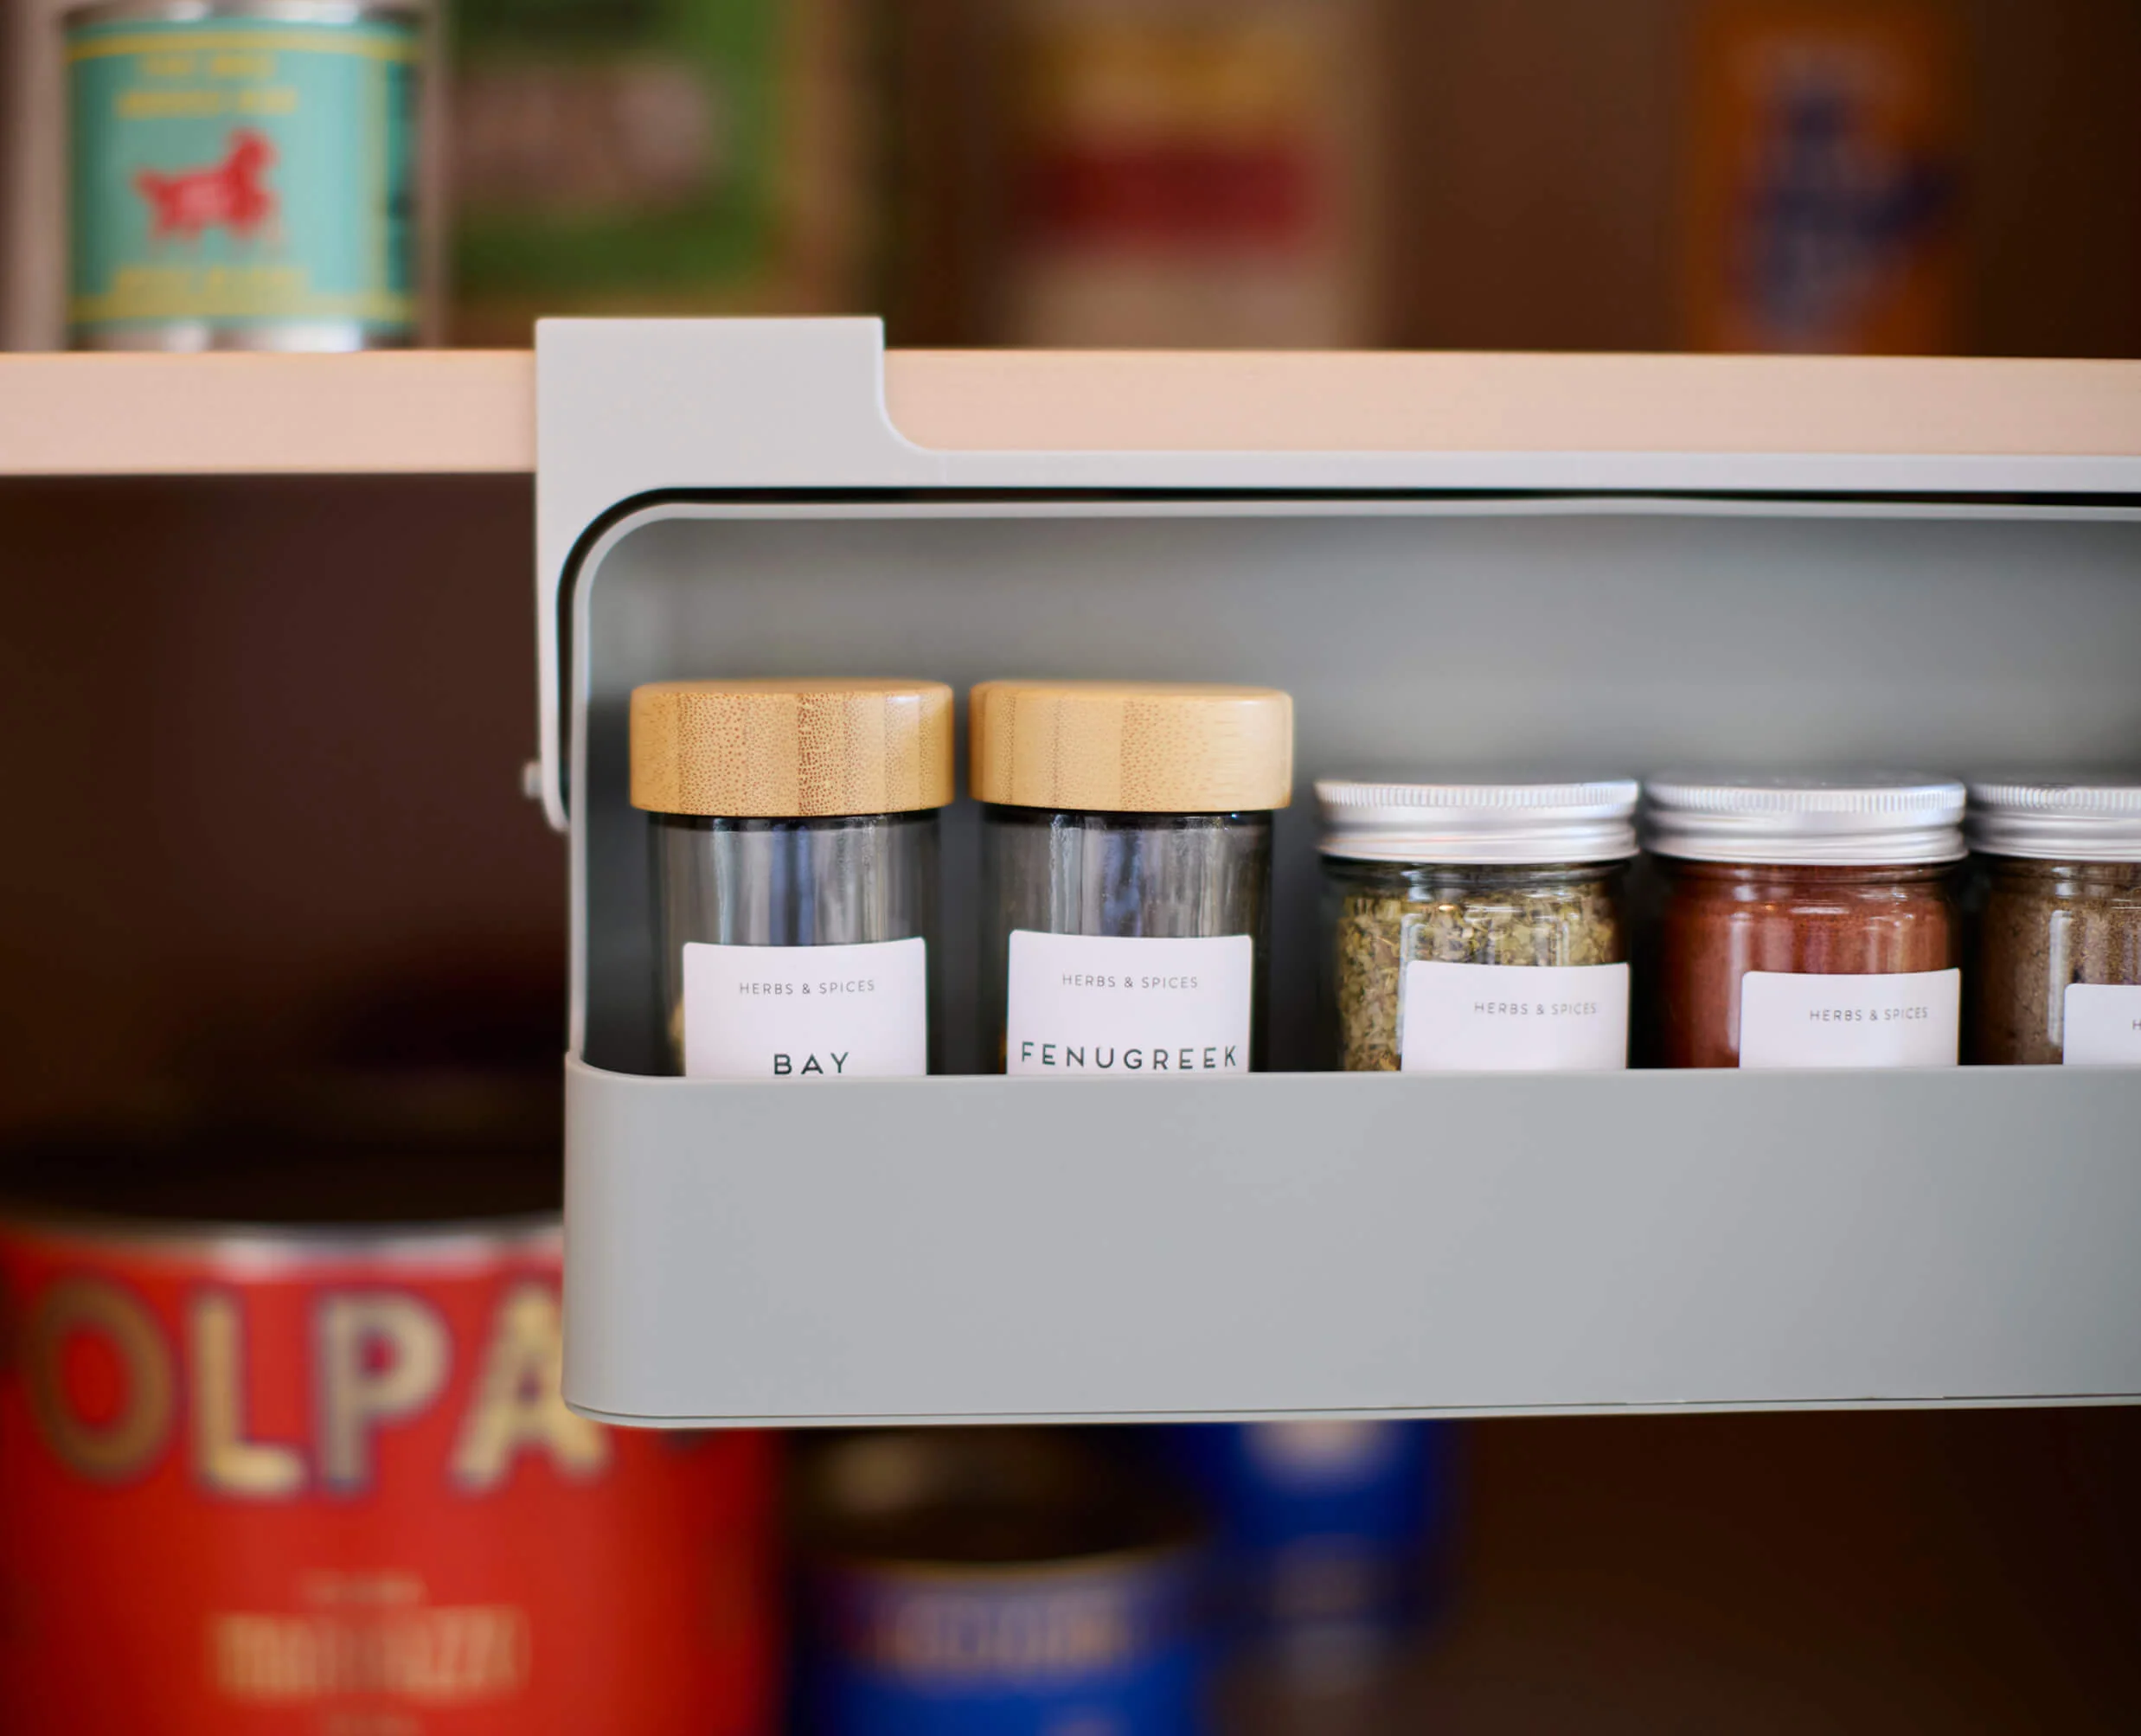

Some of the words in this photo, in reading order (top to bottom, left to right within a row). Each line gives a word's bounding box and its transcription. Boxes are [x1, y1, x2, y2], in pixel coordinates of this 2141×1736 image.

[739, 982, 793, 996] HERBS
[801, 983, 811, 995] &
[818, 979, 875, 996] SPICES
[1062, 974, 1116, 988] HERBS
[1124, 976, 1134, 988] &
[1141, 976, 1199, 990] SPICES
[1473, 1002, 1529, 1015] HERBS
[1535, 1003, 1546, 1015] &
[1551, 1003, 1598, 1015] SPICES
[1809, 1009, 1862, 1022] HERBS
[1869, 1009, 1879, 1021] &
[1883, 1007, 1929, 1022] SPICES
[772, 1051, 849, 1076] BAY
[1021, 1040, 1237, 1071] FENUGREEK
[0, 1272, 612, 1500] OLPA
